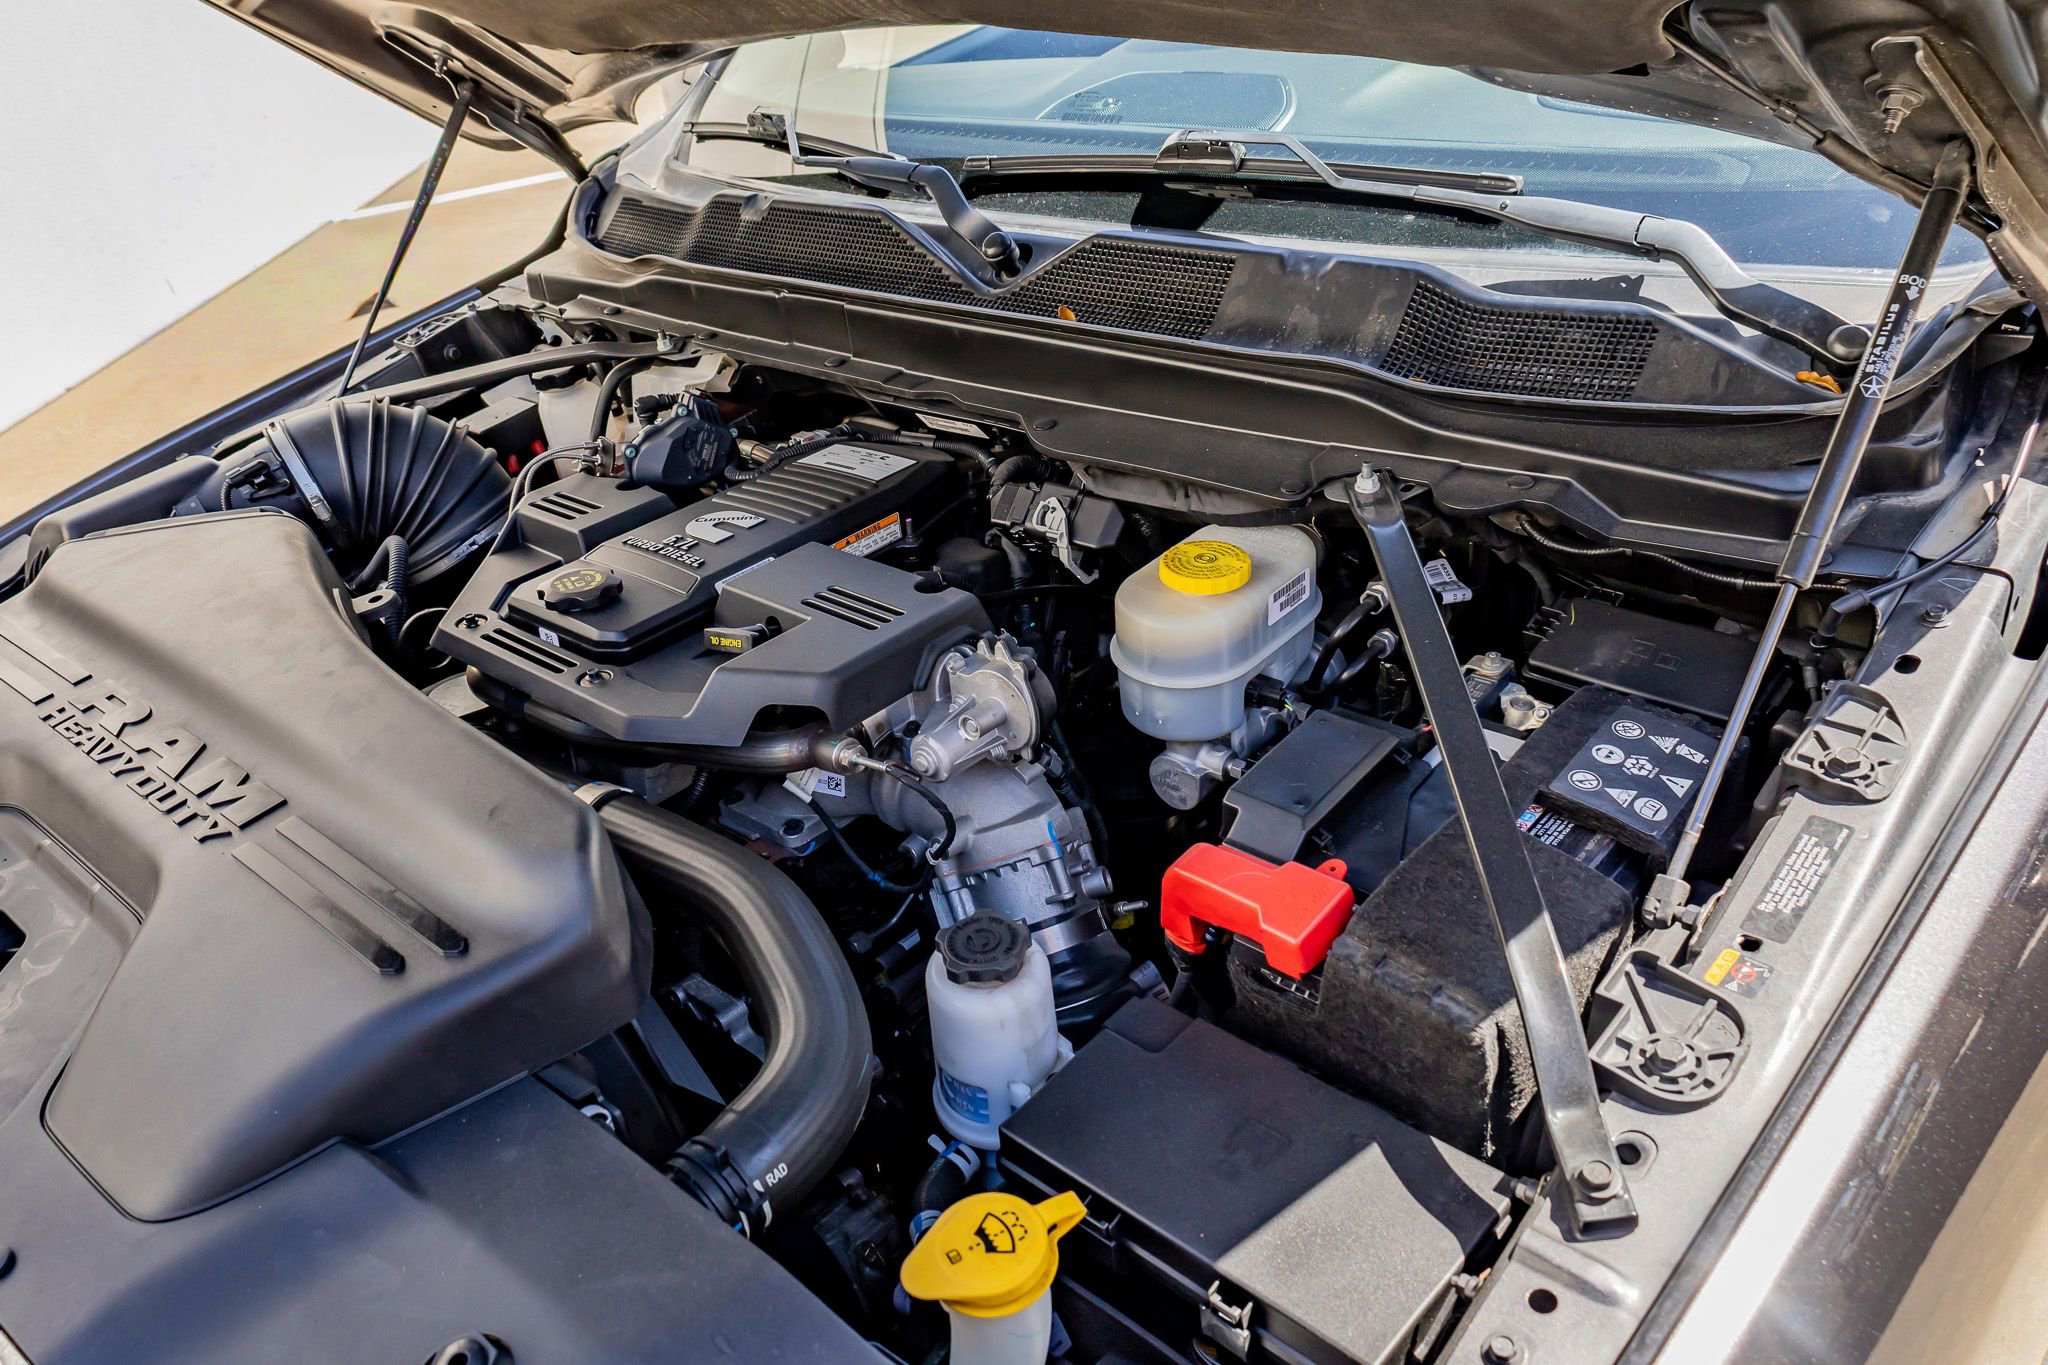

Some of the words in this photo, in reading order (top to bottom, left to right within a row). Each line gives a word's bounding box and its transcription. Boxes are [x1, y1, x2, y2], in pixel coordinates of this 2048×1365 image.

[1865, 303, 1900, 373] STABILUS
[621, 535, 662, 553] TURBO
[658, 543, 706, 568] DIESEL
[662, 534, 699, 552] 6.7L
[710, 636, 720, 645] OIL
[720, 637, 742, 648] ENGINE
[67, 678, 289, 830] RAM
[38, 705, 146, 778] HEAVY
[126, 775, 233, 845] DUTY
[765, 1161, 788, 1187] RAD
